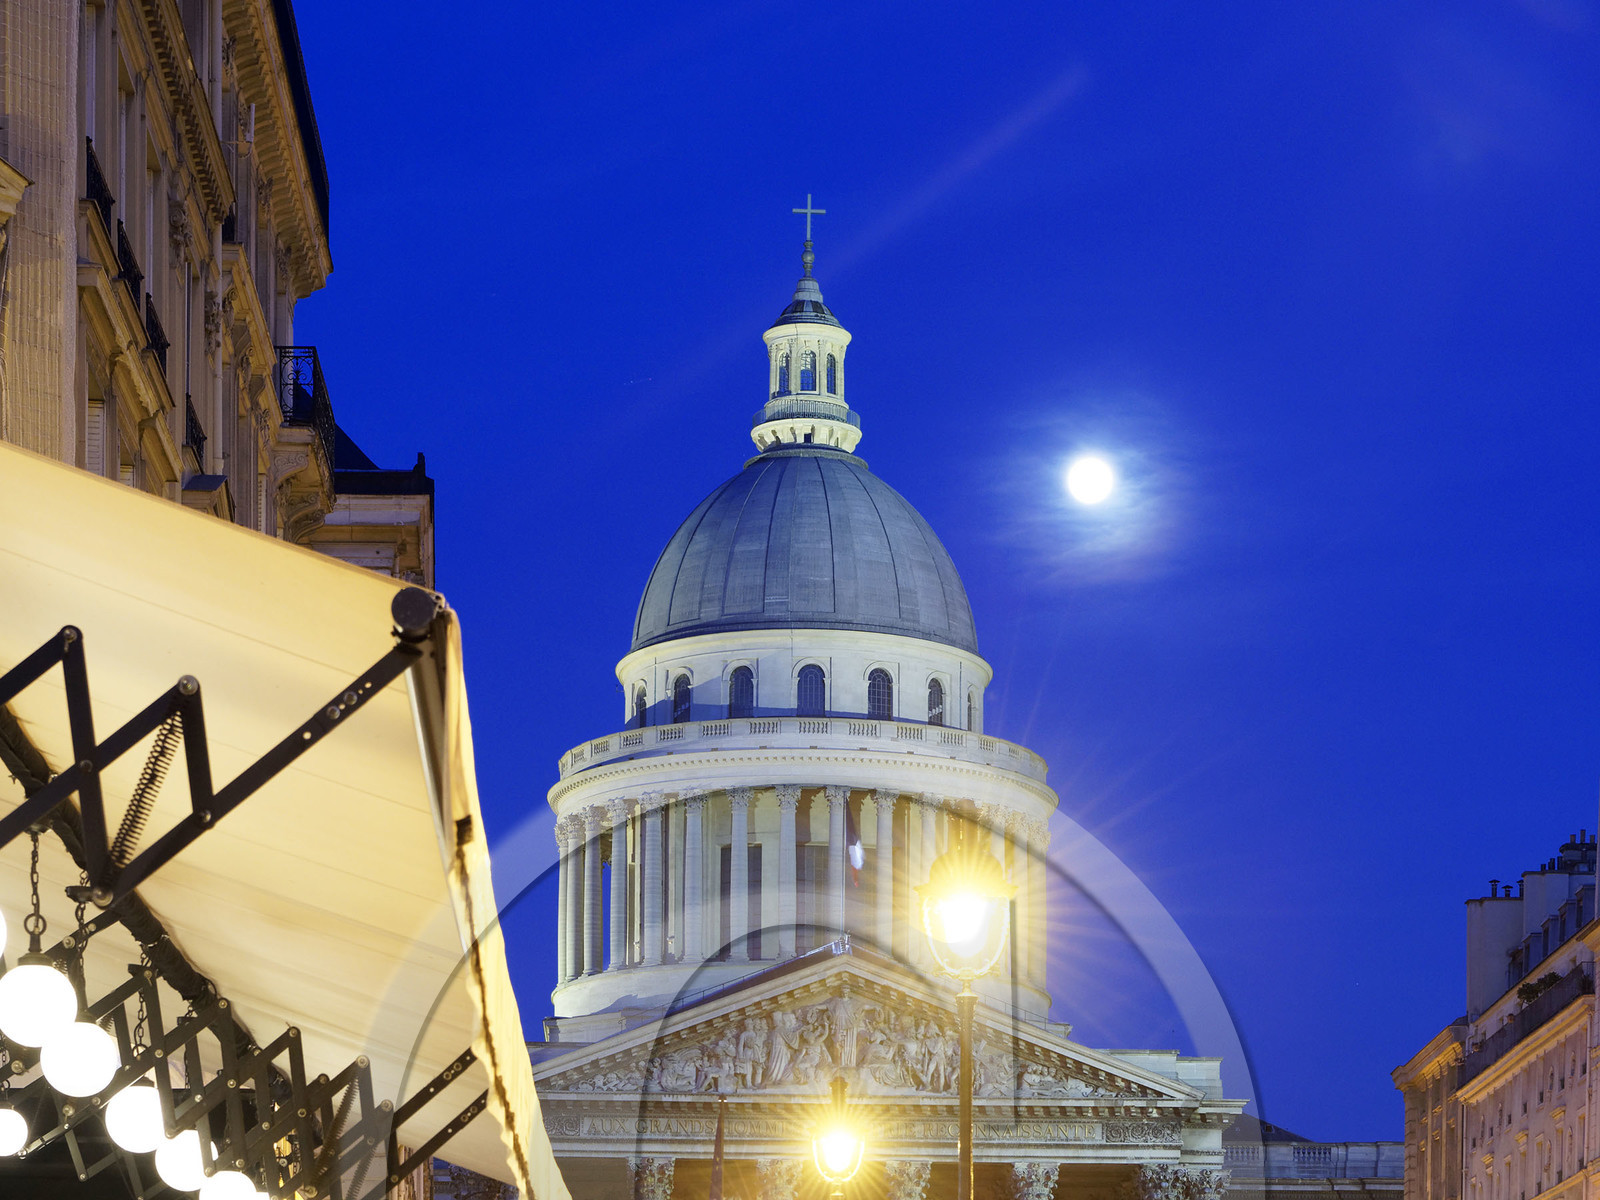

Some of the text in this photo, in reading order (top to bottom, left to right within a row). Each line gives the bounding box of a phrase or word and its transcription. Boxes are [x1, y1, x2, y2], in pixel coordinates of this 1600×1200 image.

[587, 1118, 630, 1134] AUX
[635, 1118, 715, 1135] GRANDS
[923, 1122, 1097, 1139] RECNNAISSANTE
